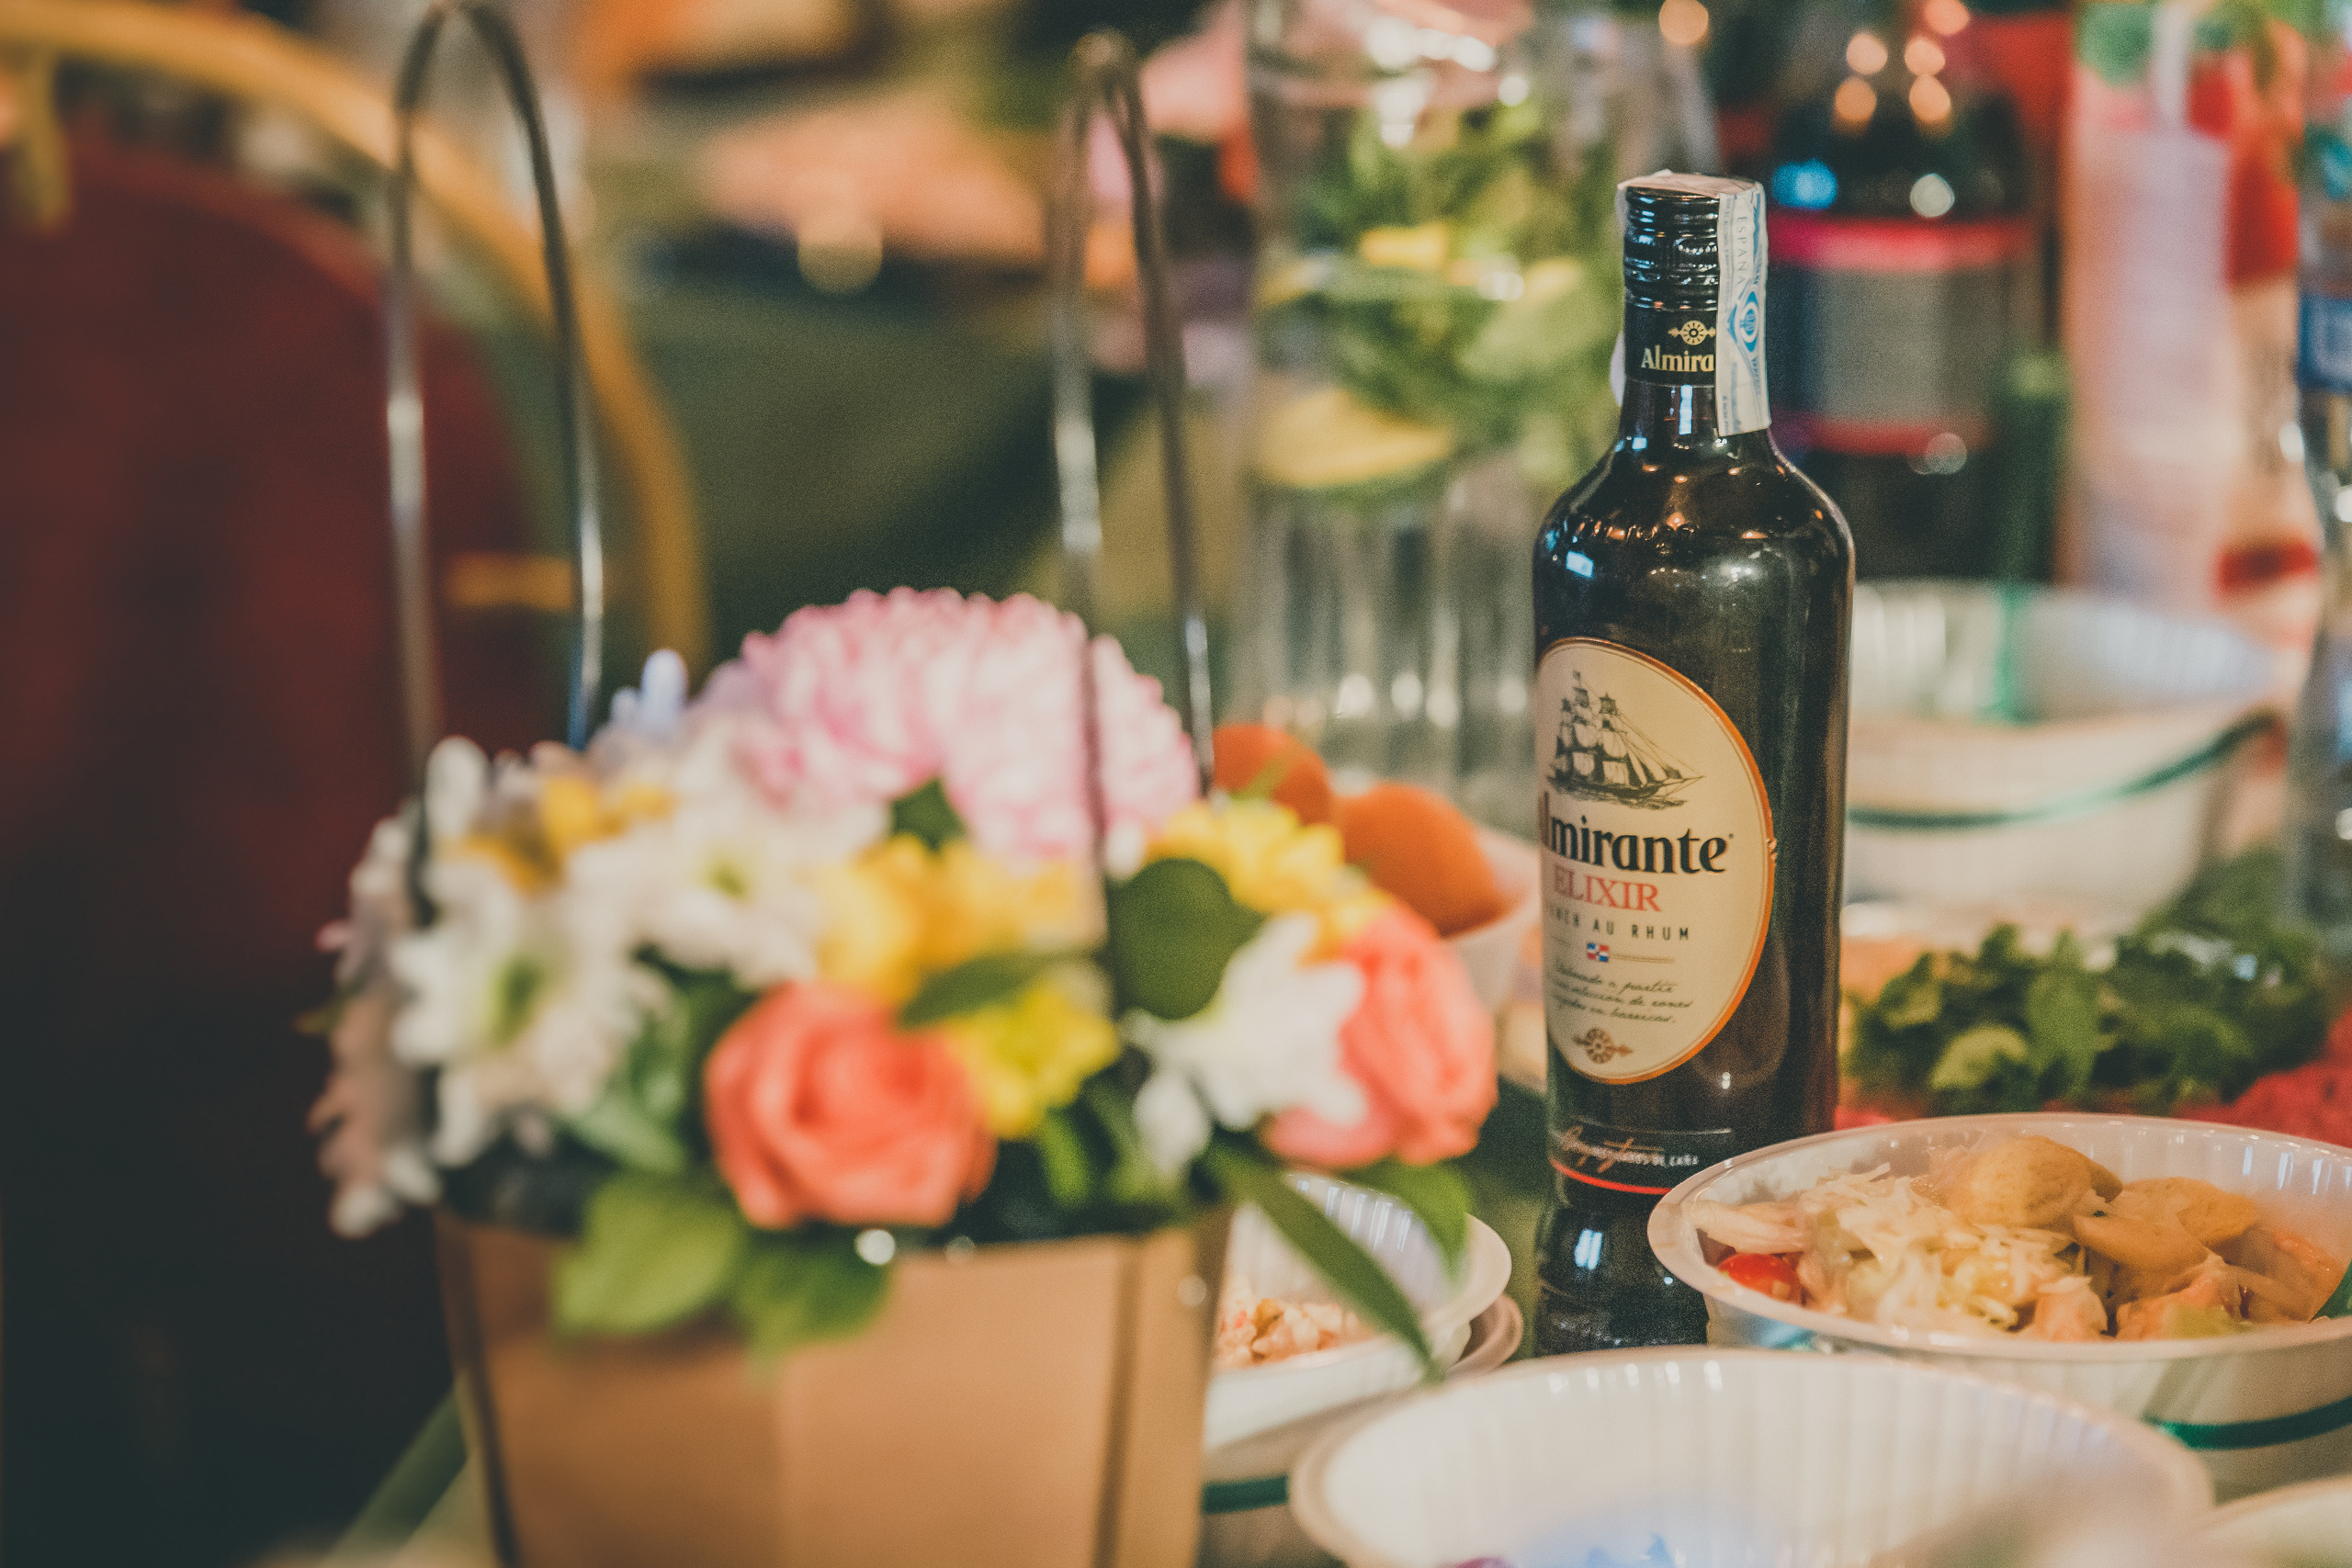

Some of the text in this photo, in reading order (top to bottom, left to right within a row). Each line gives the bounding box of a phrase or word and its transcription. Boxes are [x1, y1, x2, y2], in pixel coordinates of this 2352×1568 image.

[1641, 344, 1715, 372] Almira
[1553, 863, 1662, 912] ELIXIR
[1593, 919, 1614, 935] AU
[1632, 924, 1690, 941] RHUM
[1629, 996, 1645, 1007] de
